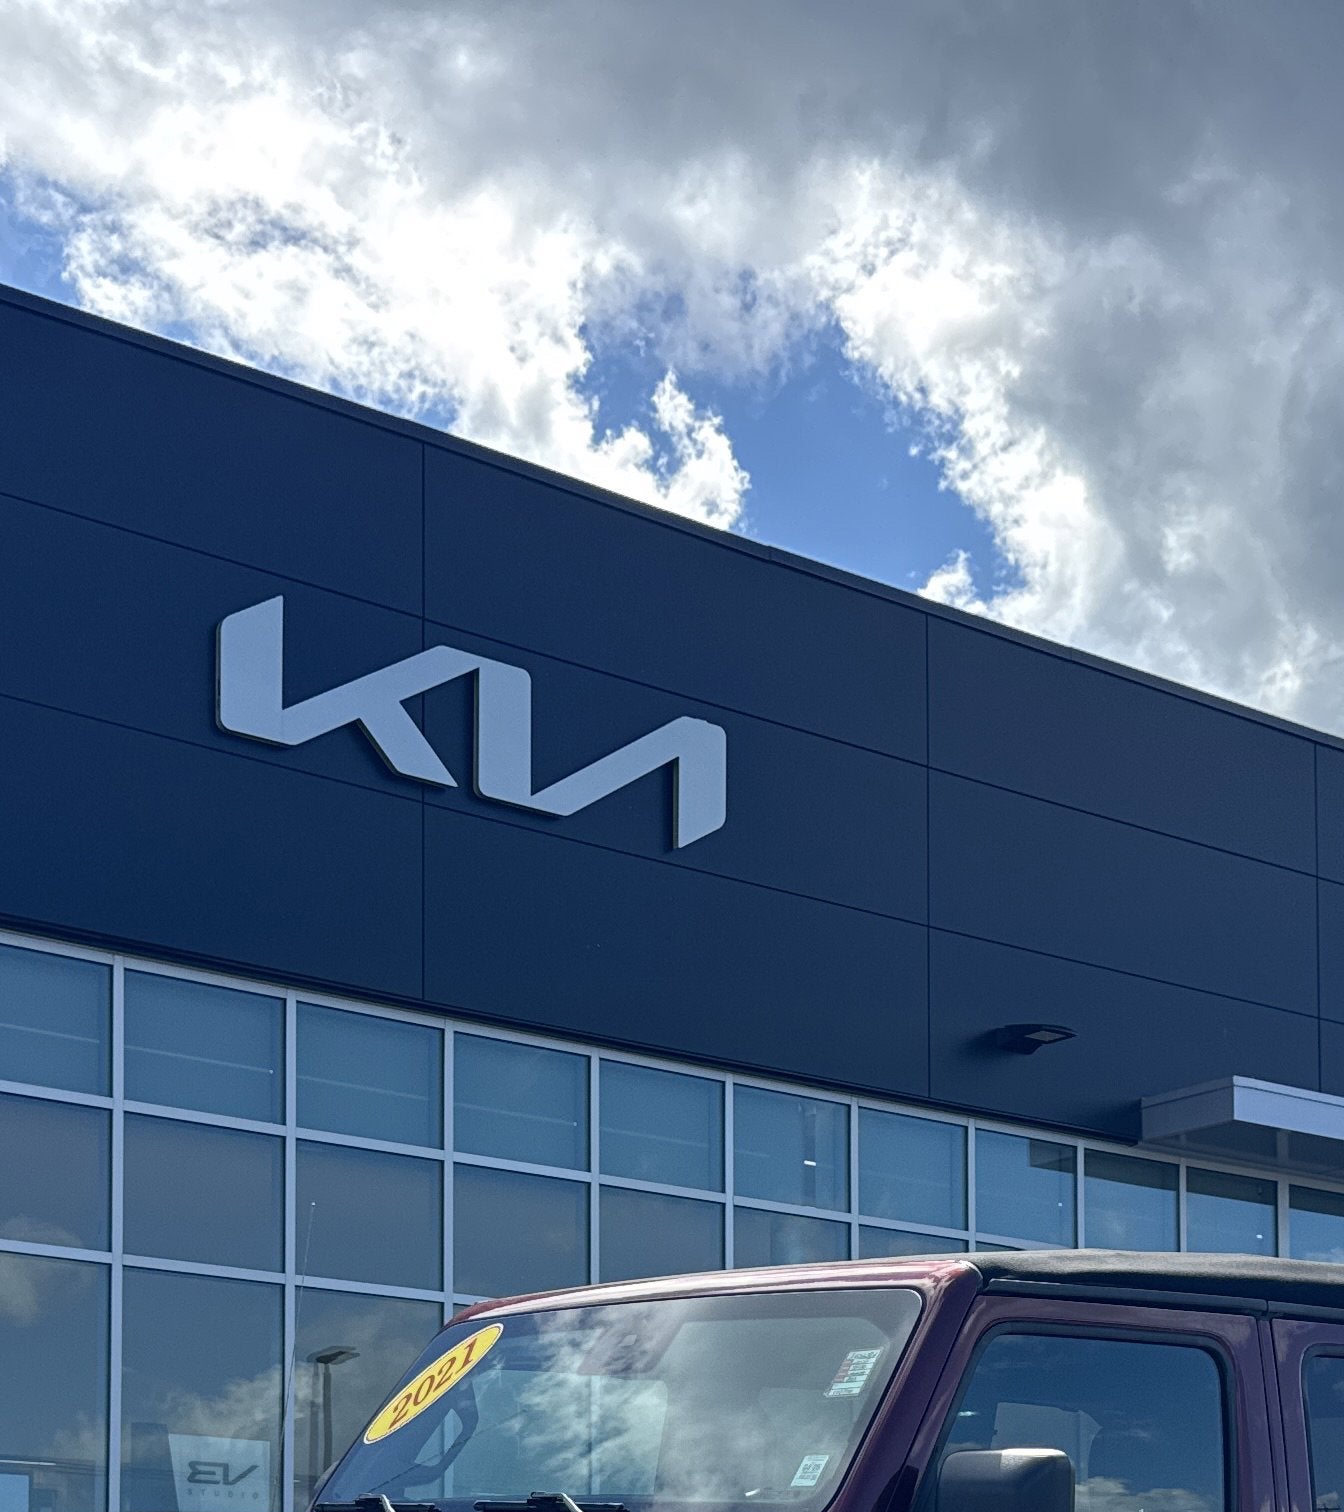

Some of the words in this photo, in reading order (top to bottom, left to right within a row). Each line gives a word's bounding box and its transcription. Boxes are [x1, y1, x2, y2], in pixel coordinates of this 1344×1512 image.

[216, 595, 726, 849] KIA
[388, 1338, 478, 1430] 2021
[186, 1488, 258, 1500] STUDIO
[187, 1461, 260, 1486] EV
